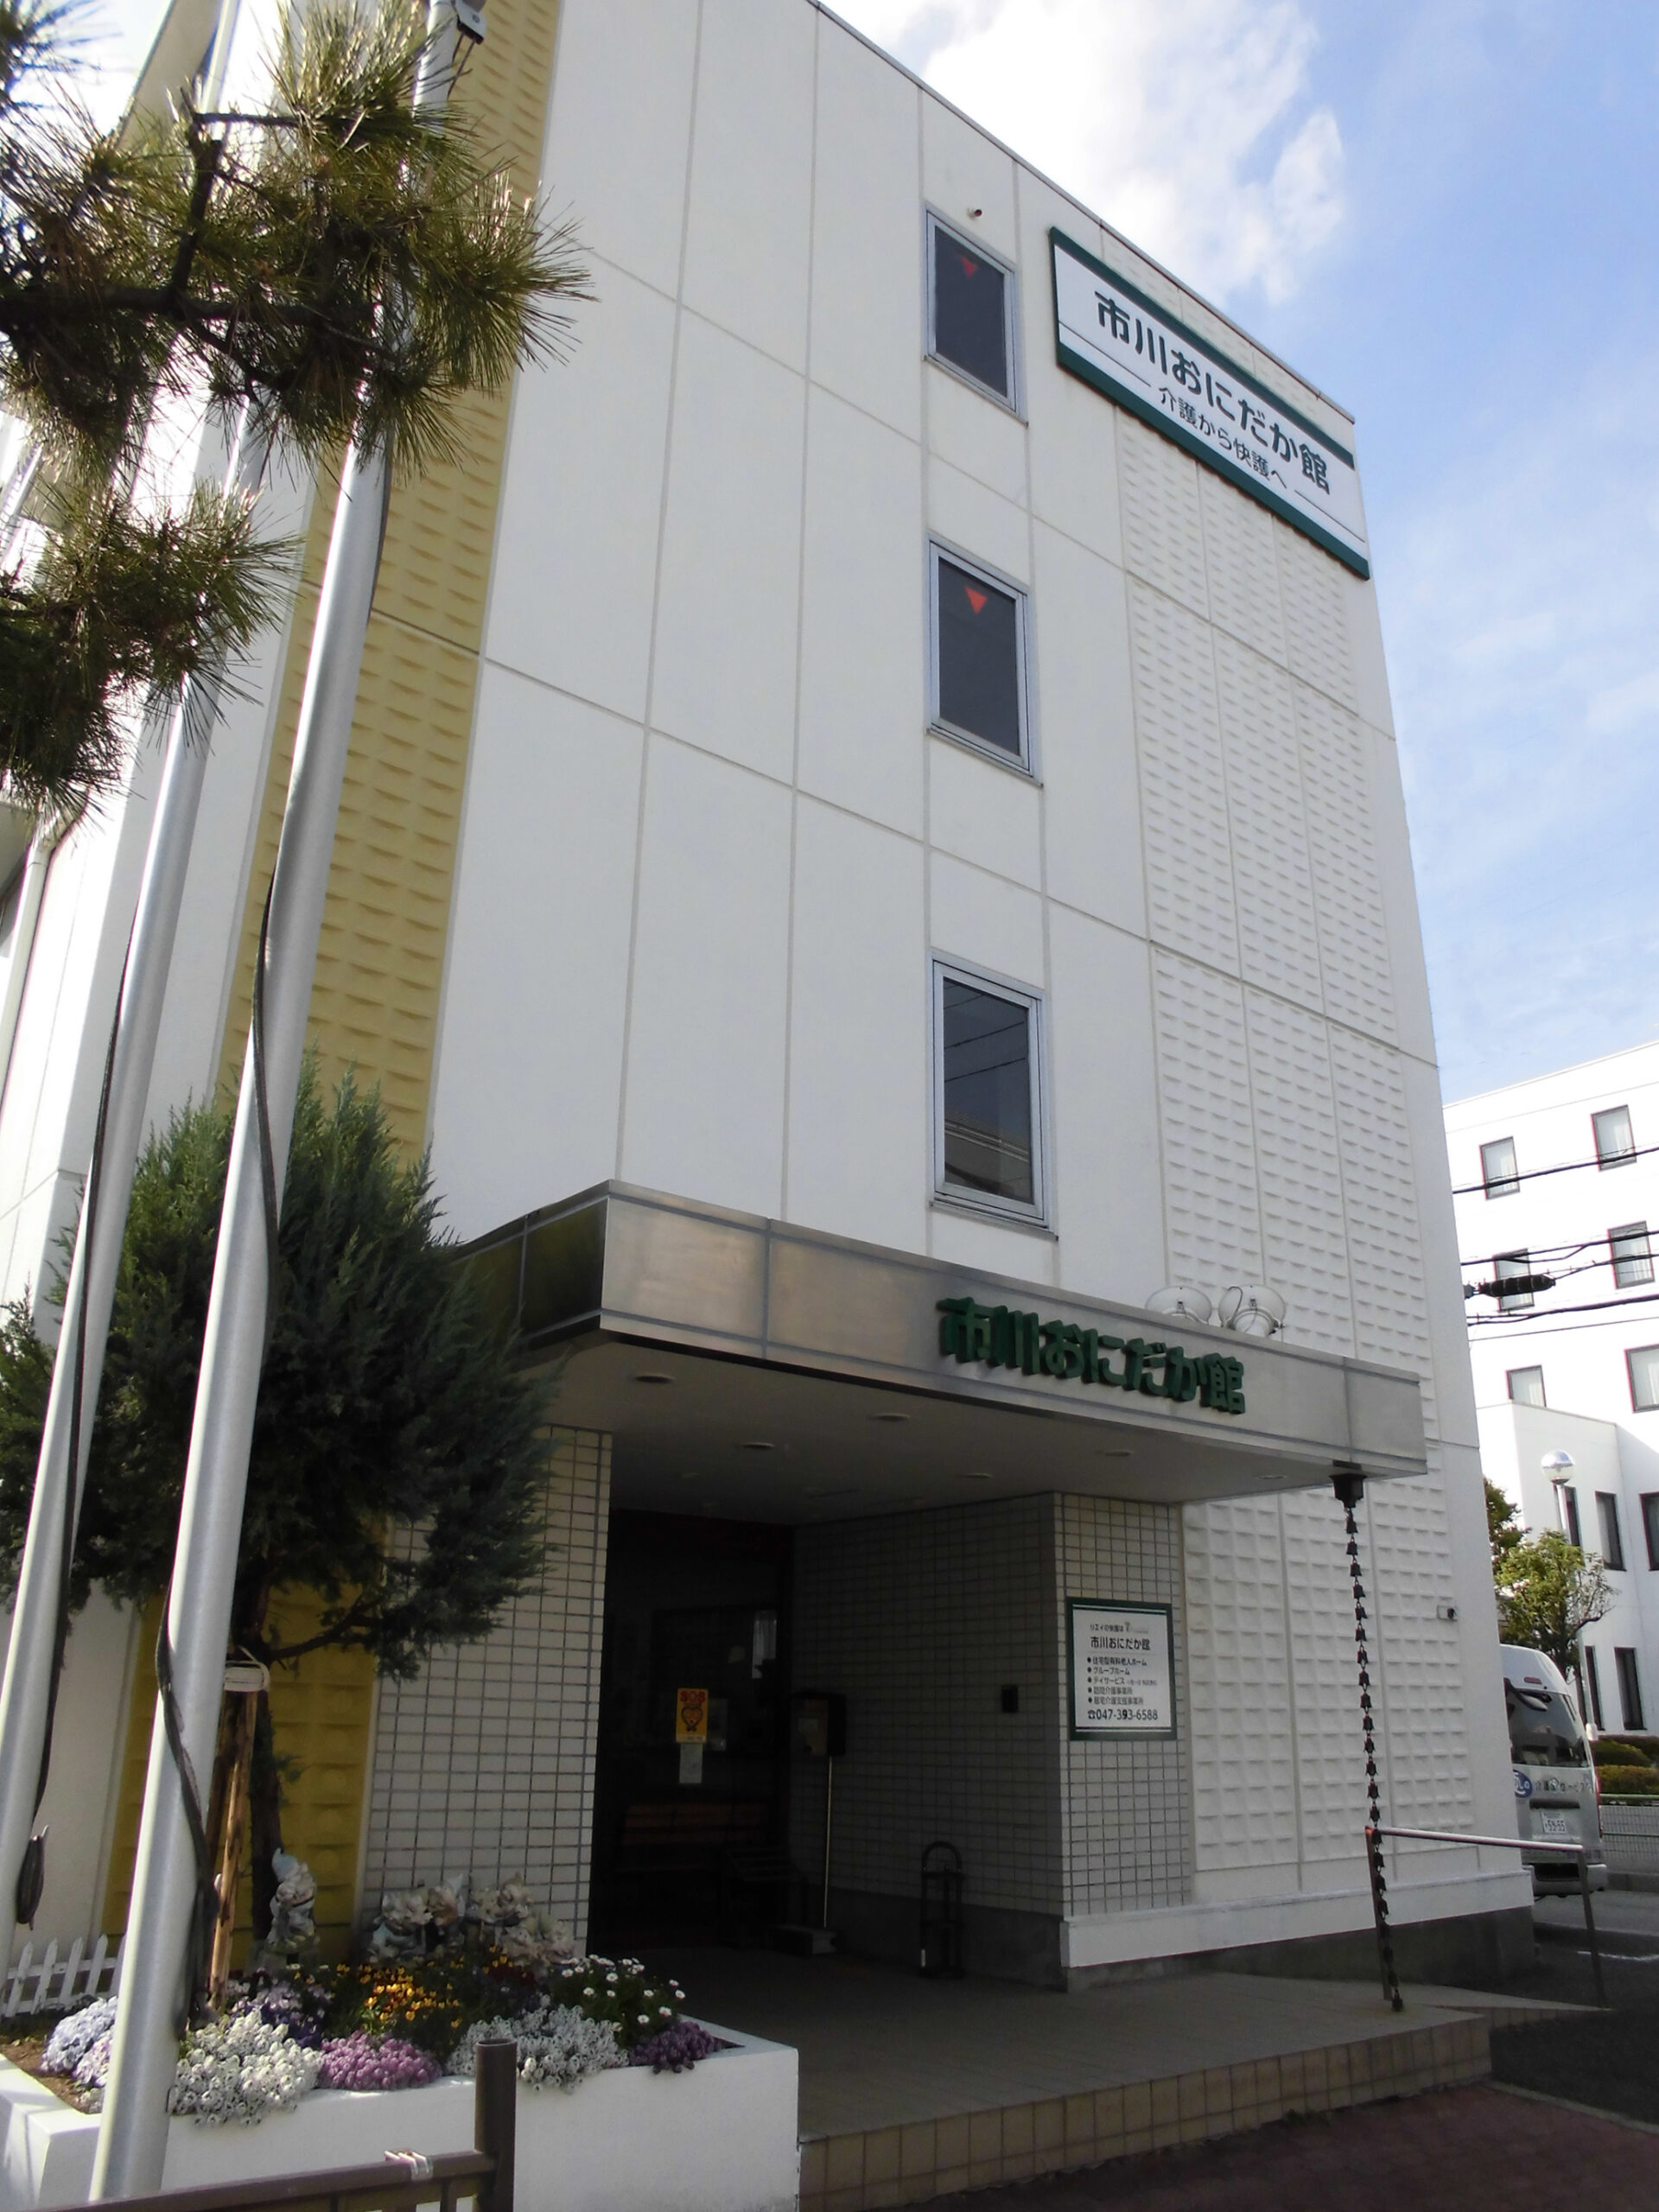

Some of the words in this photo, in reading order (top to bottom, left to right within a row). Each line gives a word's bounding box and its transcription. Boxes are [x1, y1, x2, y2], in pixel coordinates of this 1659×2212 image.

[1095, 290, 1330, 494] 市川おにだか館
[1159, 386, 1287, 489] 介護から快護へ
[937, 1296, 1246, 1414] 市川おにだか館
[1090, 1637, 1150, 1651] 市川おにだか館
[1096, 1709, 1158, 1720] 047-393-6588
